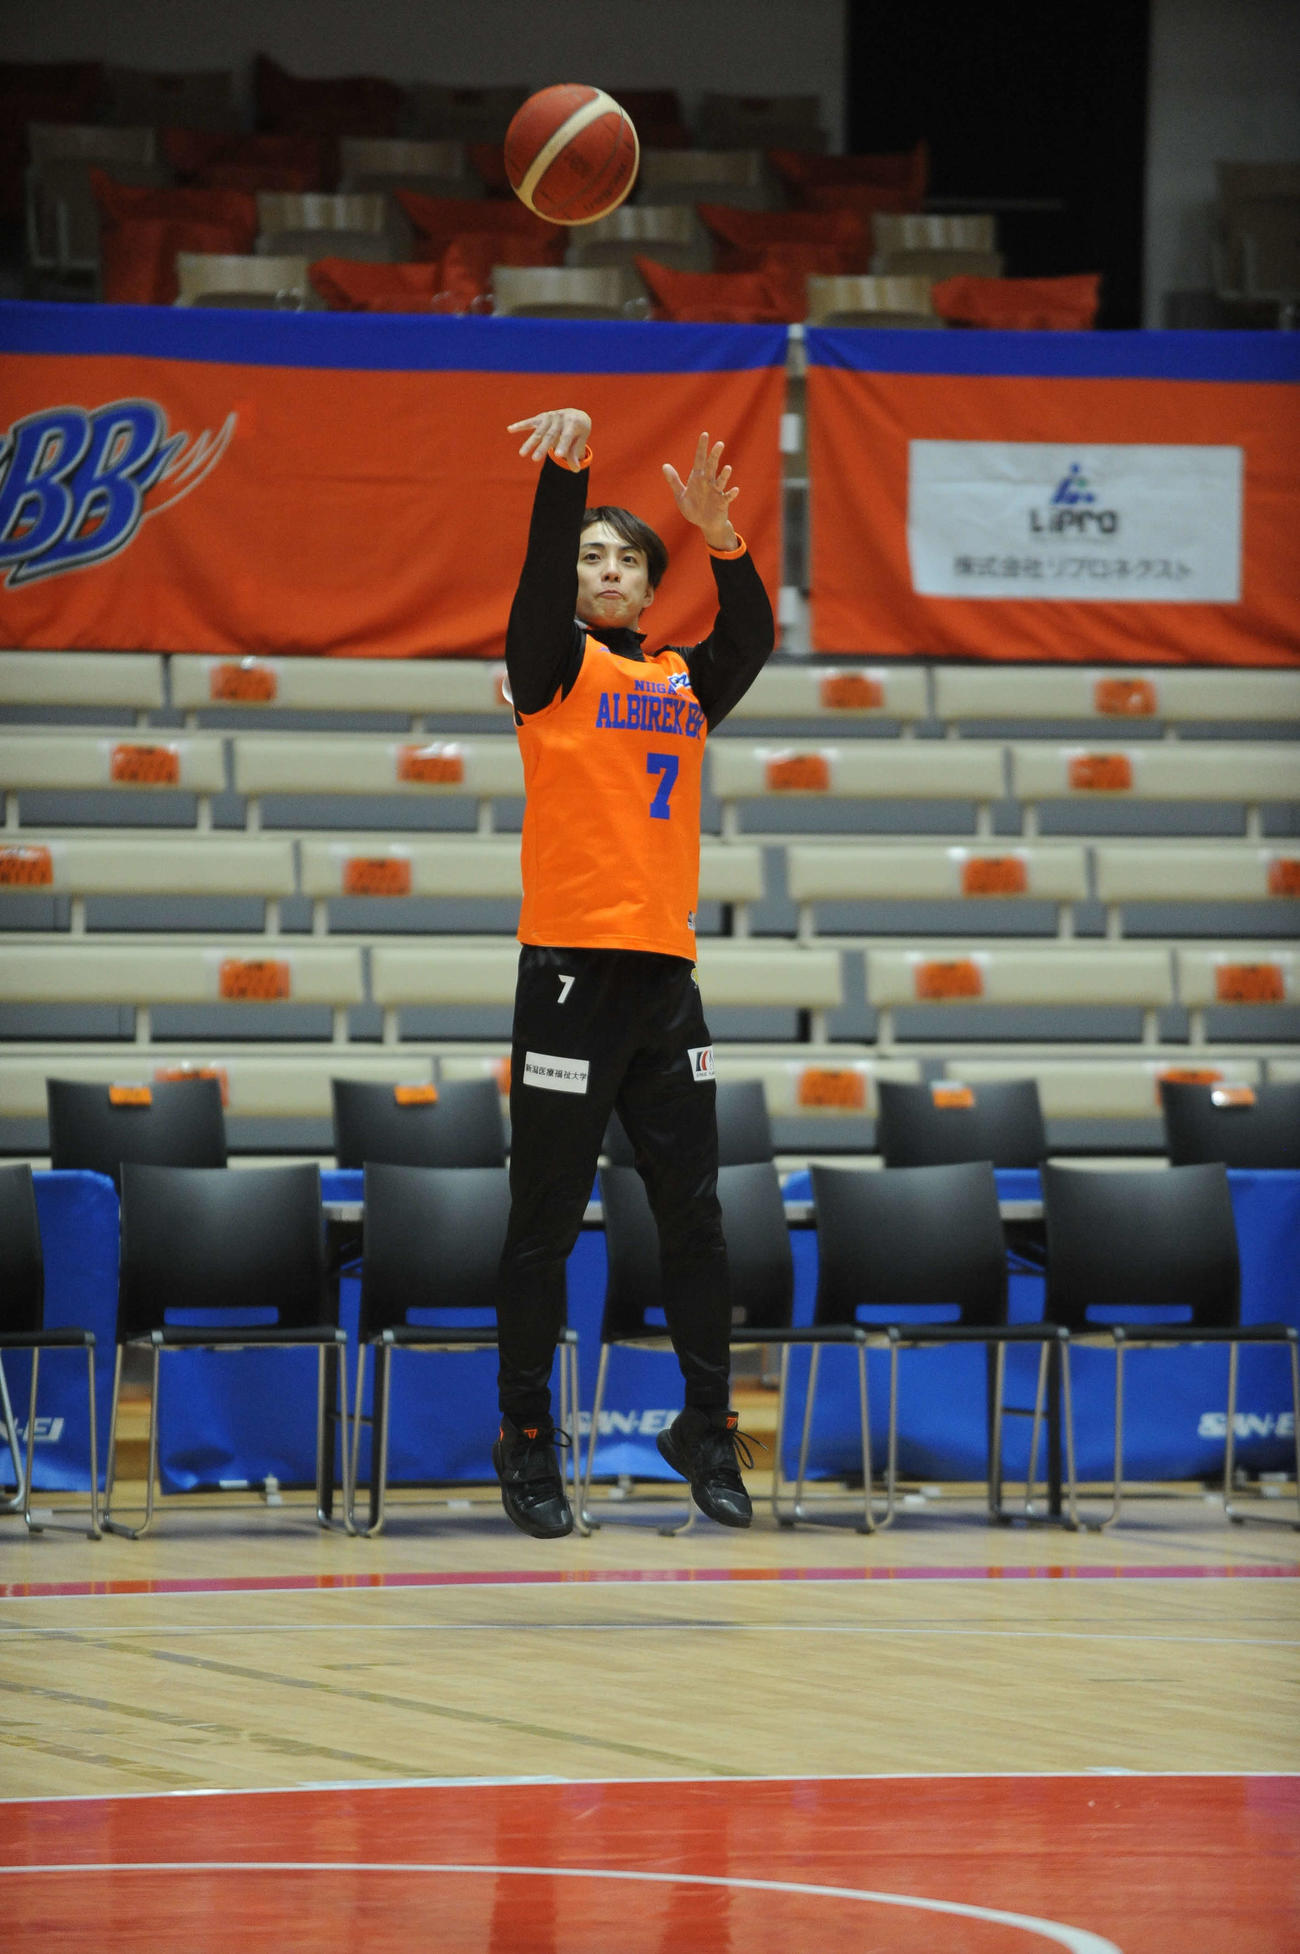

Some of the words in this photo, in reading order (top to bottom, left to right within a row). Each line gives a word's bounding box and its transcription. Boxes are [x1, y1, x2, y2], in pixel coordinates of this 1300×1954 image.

[634, 679, 690, 697] NIIGA
[595, 692, 686, 735] ALBIREX
[646, 752, 679, 820] 7
[556, 973, 576, 1004] 7
